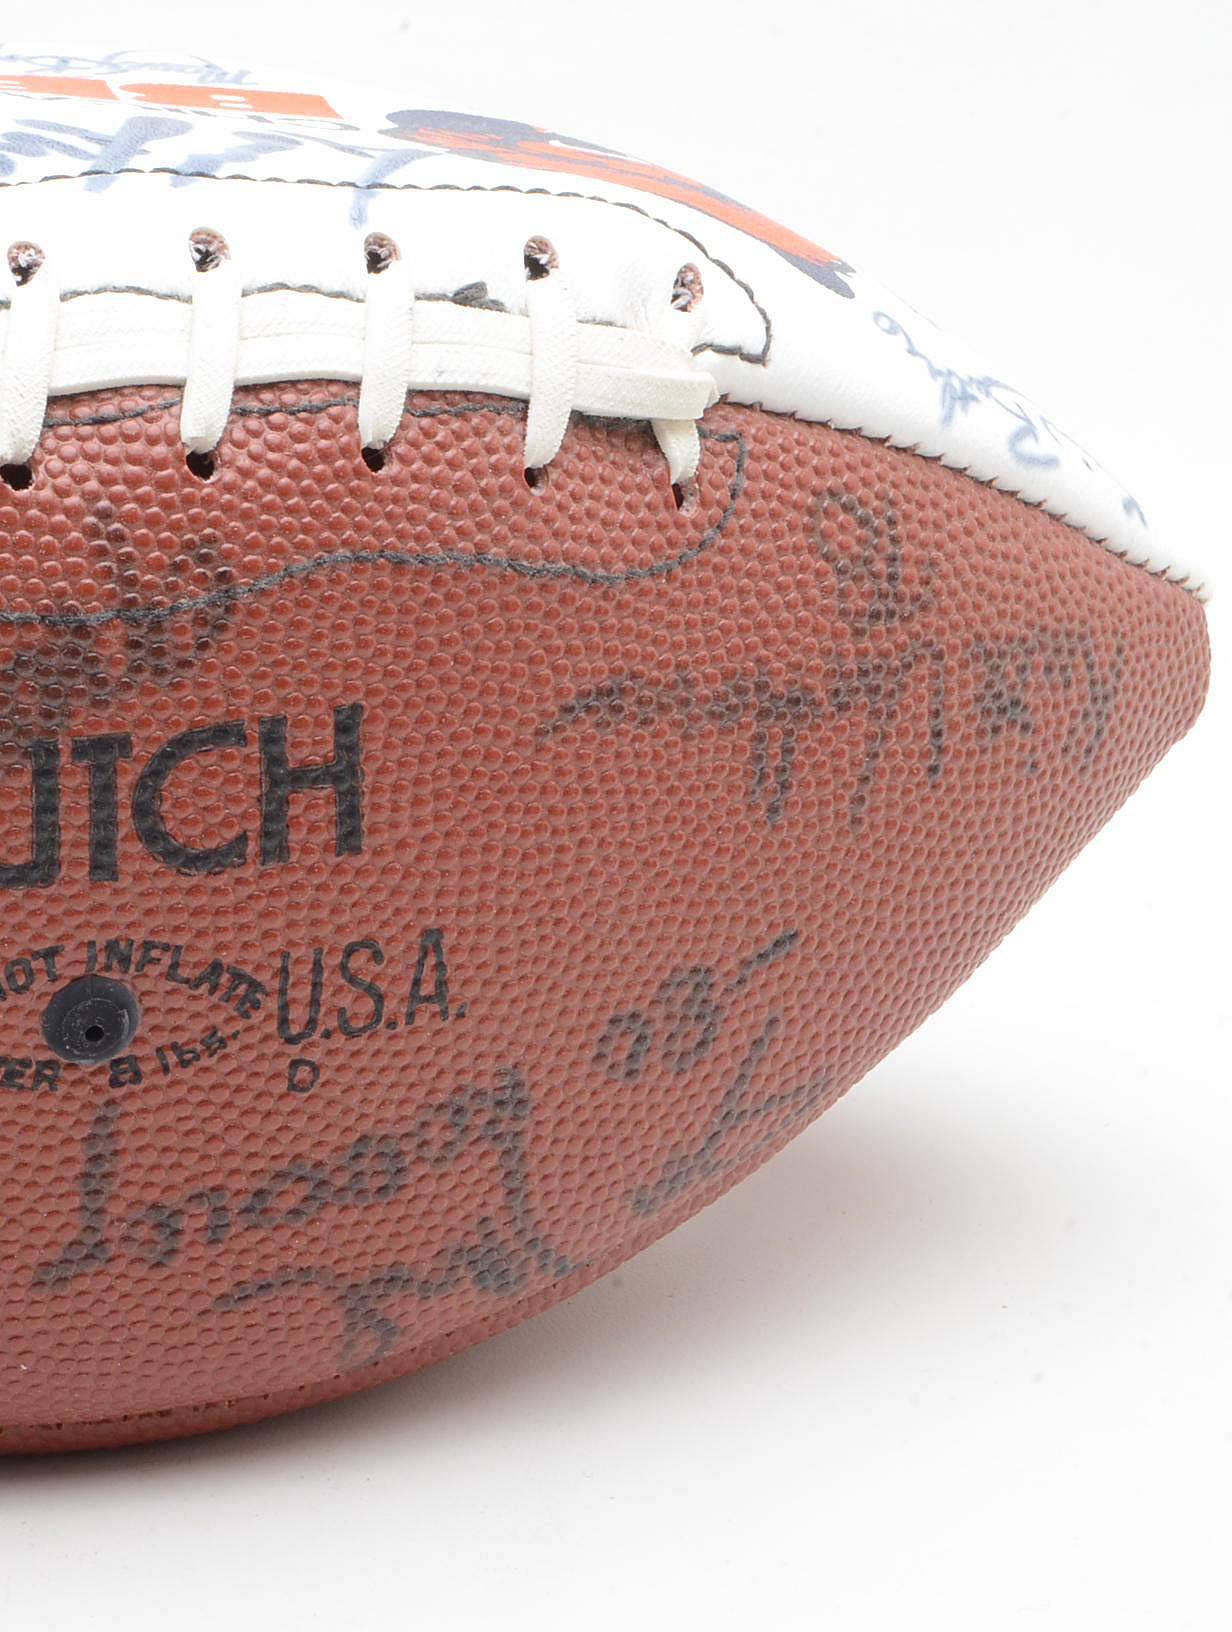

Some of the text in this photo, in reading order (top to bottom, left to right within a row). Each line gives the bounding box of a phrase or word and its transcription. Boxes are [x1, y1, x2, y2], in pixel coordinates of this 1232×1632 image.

[85, 938, 268, 1020] INFLATE
[277, 928, 468, 1045] U.S.A.
[287, 1058, 321, 1093] D
